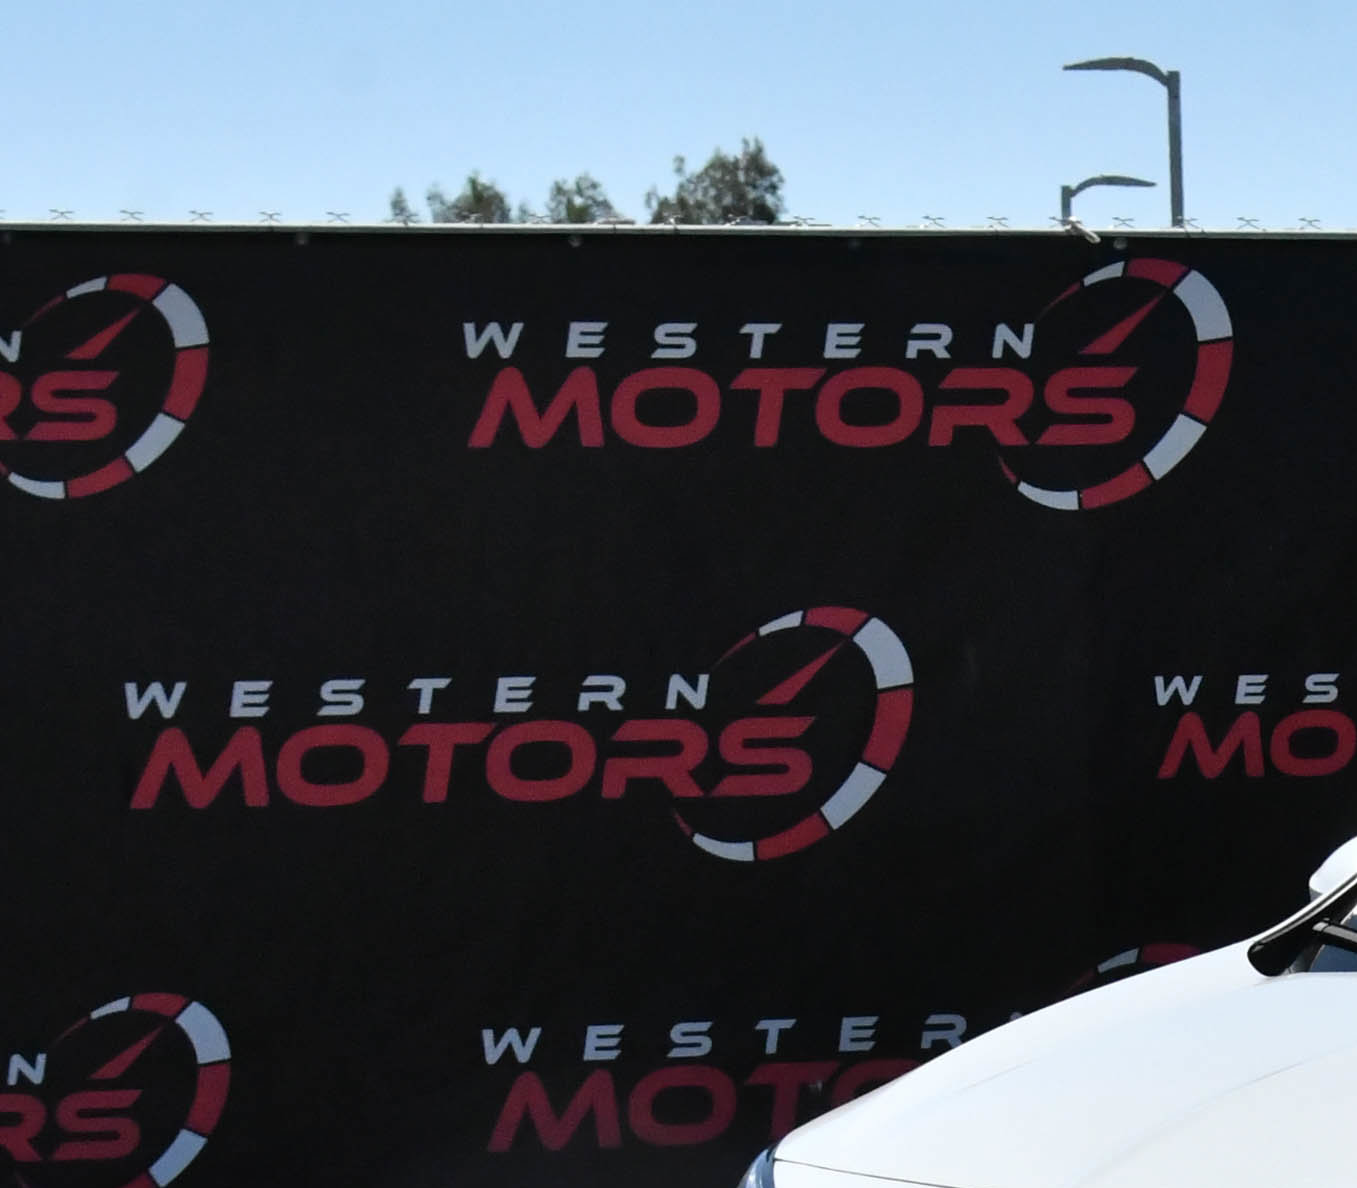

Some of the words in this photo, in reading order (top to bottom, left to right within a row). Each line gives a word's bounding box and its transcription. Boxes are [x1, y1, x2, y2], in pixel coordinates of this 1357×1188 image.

[464, 321, 1034, 360] WESTERN
[467, 365, 1138, 449] MOTORS
[125, 673, 710, 719] WESTERN
[129, 715, 816, 809] MOTORS
[482, 1013, 1020, 1065] WESTER
